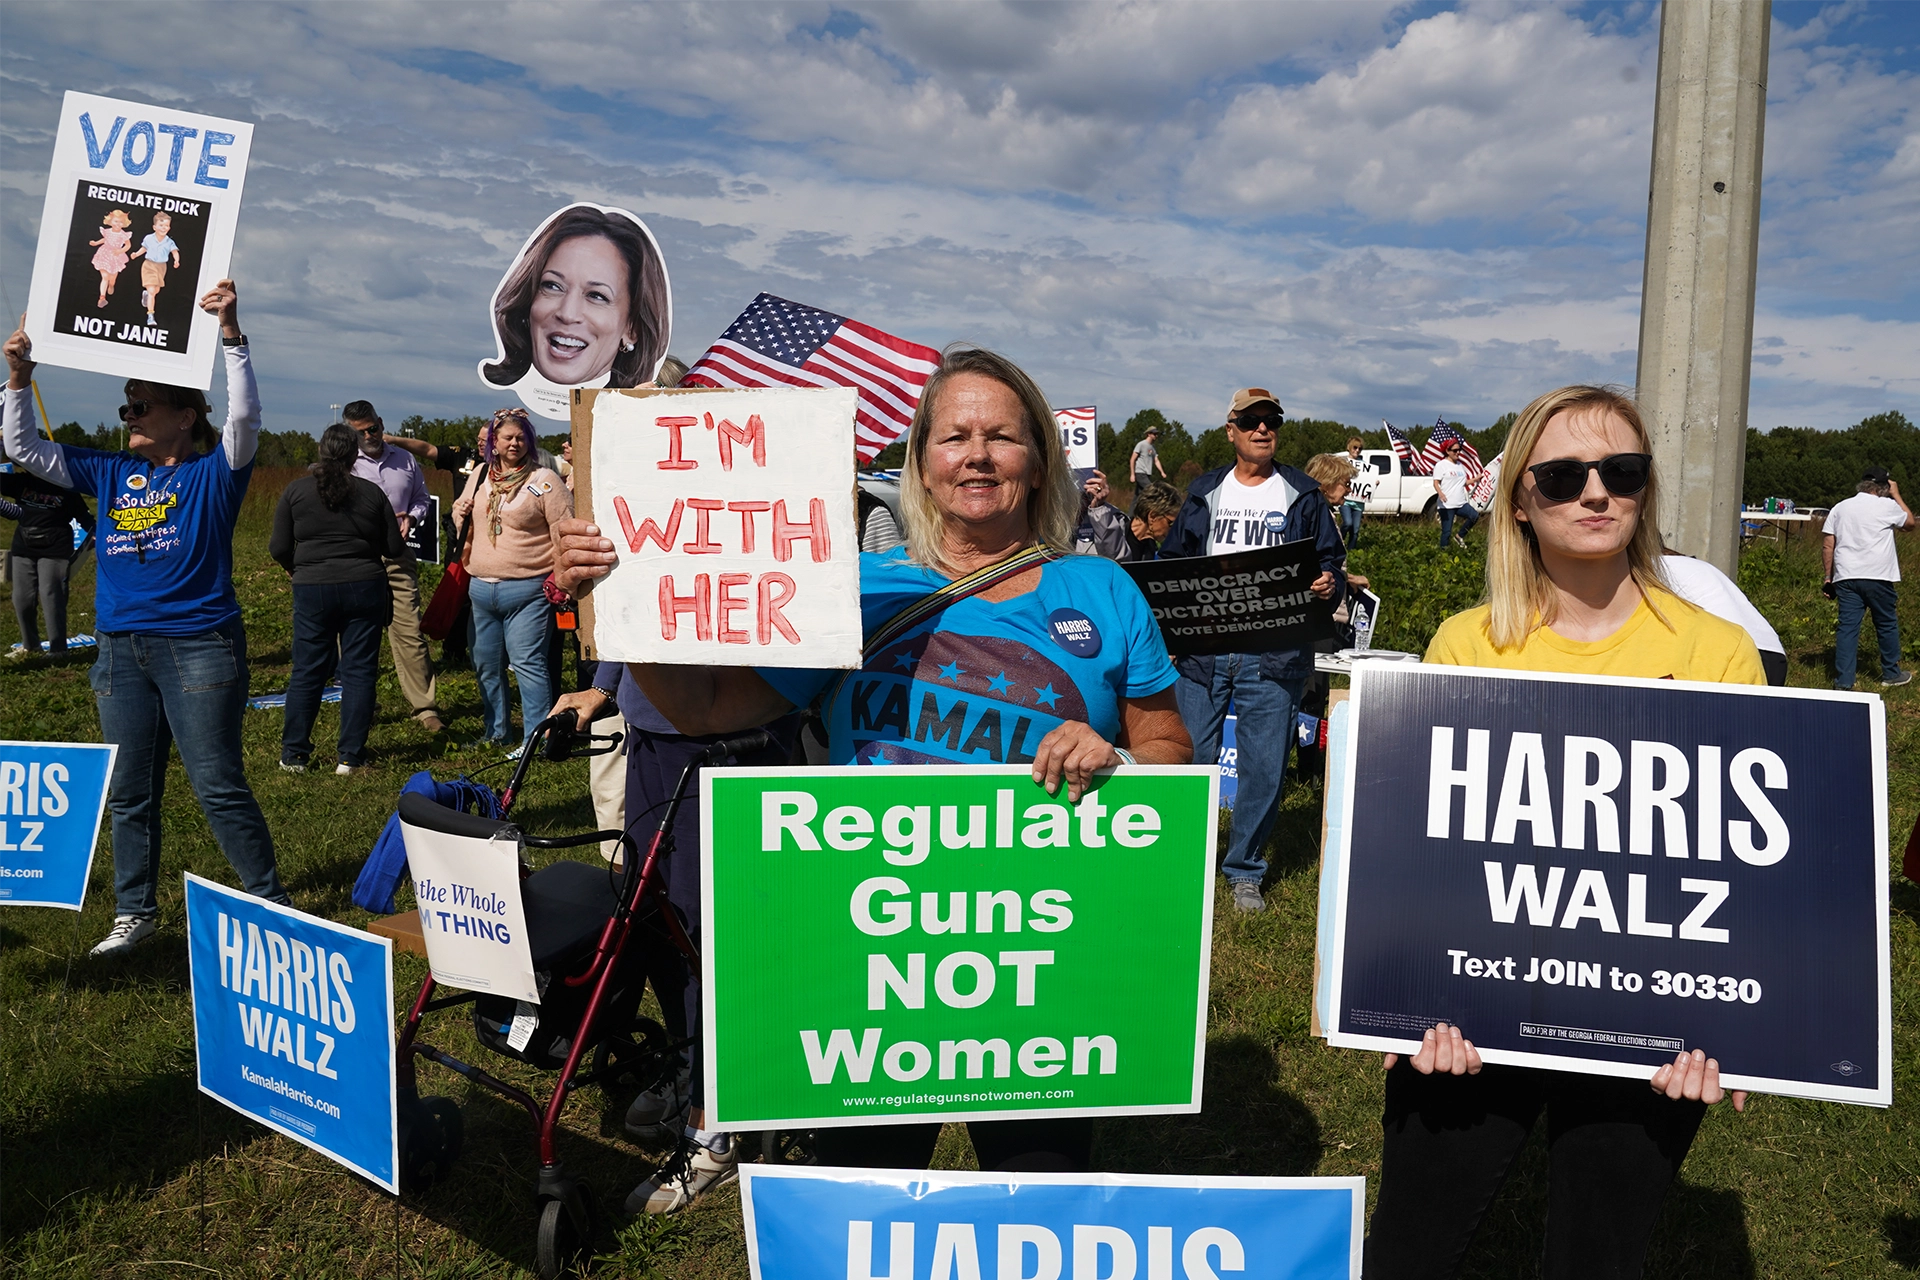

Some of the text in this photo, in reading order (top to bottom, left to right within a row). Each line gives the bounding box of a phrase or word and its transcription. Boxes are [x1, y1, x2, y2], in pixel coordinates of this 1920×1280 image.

[78, 111, 236, 189] VOTE
[87, 184, 200, 216] REGULATE DICK
[73, 315, 169, 347] NOT JANE
[654, 411, 766, 472] I'M
[1063, 427, 1088, 446] IS
[613, 495, 831, 563] WITH
[1216, 508, 1241, 517] When
[1244, 509, 1258, 517] We
[146, 527, 168, 538] Hope
[406, 541, 421, 549] 0330
[1213, 519, 1239, 545] WE
[1148, 563, 1301, 594] DEMOCRACY
[1195, 585, 1262, 604] OVER
[658, 572, 801, 646] HER
[1152, 589, 1317, 620] DICTATORSHIP
[1054, 619, 1092, 635] HARRIS
[1066, 632, 1091, 642] WALZ
[1170, 614, 1306, 636] VOTE DEMOCRAT
[851, 680, 1037, 764] KAMAL
[1426, 726, 1791, 867] HARRIS
[761, 789, 1162, 866] Regulate
[0, 866, 44, 879] is.com
[420, 879, 447, 903] the
[451, 883, 506, 916] Whole
[850, 876, 1073, 936] Guns
[1483, 861, 1730, 944] WALZ
[436, 911, 511, 945] THING
[218, 912, 357, 1034] HARRIS
[867, 950, 1055, 1011] NOT
[1447, 949, 1762, 1004] Text JOIN to 30330
[237, 1002, 338, 1081] WALZ
[1523, 1026, 1536, 1035] PAID
[1549, 1028, 1556, 1037] BY
[1557, 1029, 1567, 1038] THE
[1568, 1031, 1592, 1040] GEORGIA
[1594, 1034, 1617, 1043] FEDERAL
[1618, 1036, 1647, 1046] ELECTIONS
[1648, 1039, 1681, 1050] COMMITTEE
[800, 1028, 1117, 1085] Women
[241, 1064, 341, 1119] KamalaHarris.com
[843, 1087, 1074, 1107] www.regulategunsnotwomen.com
